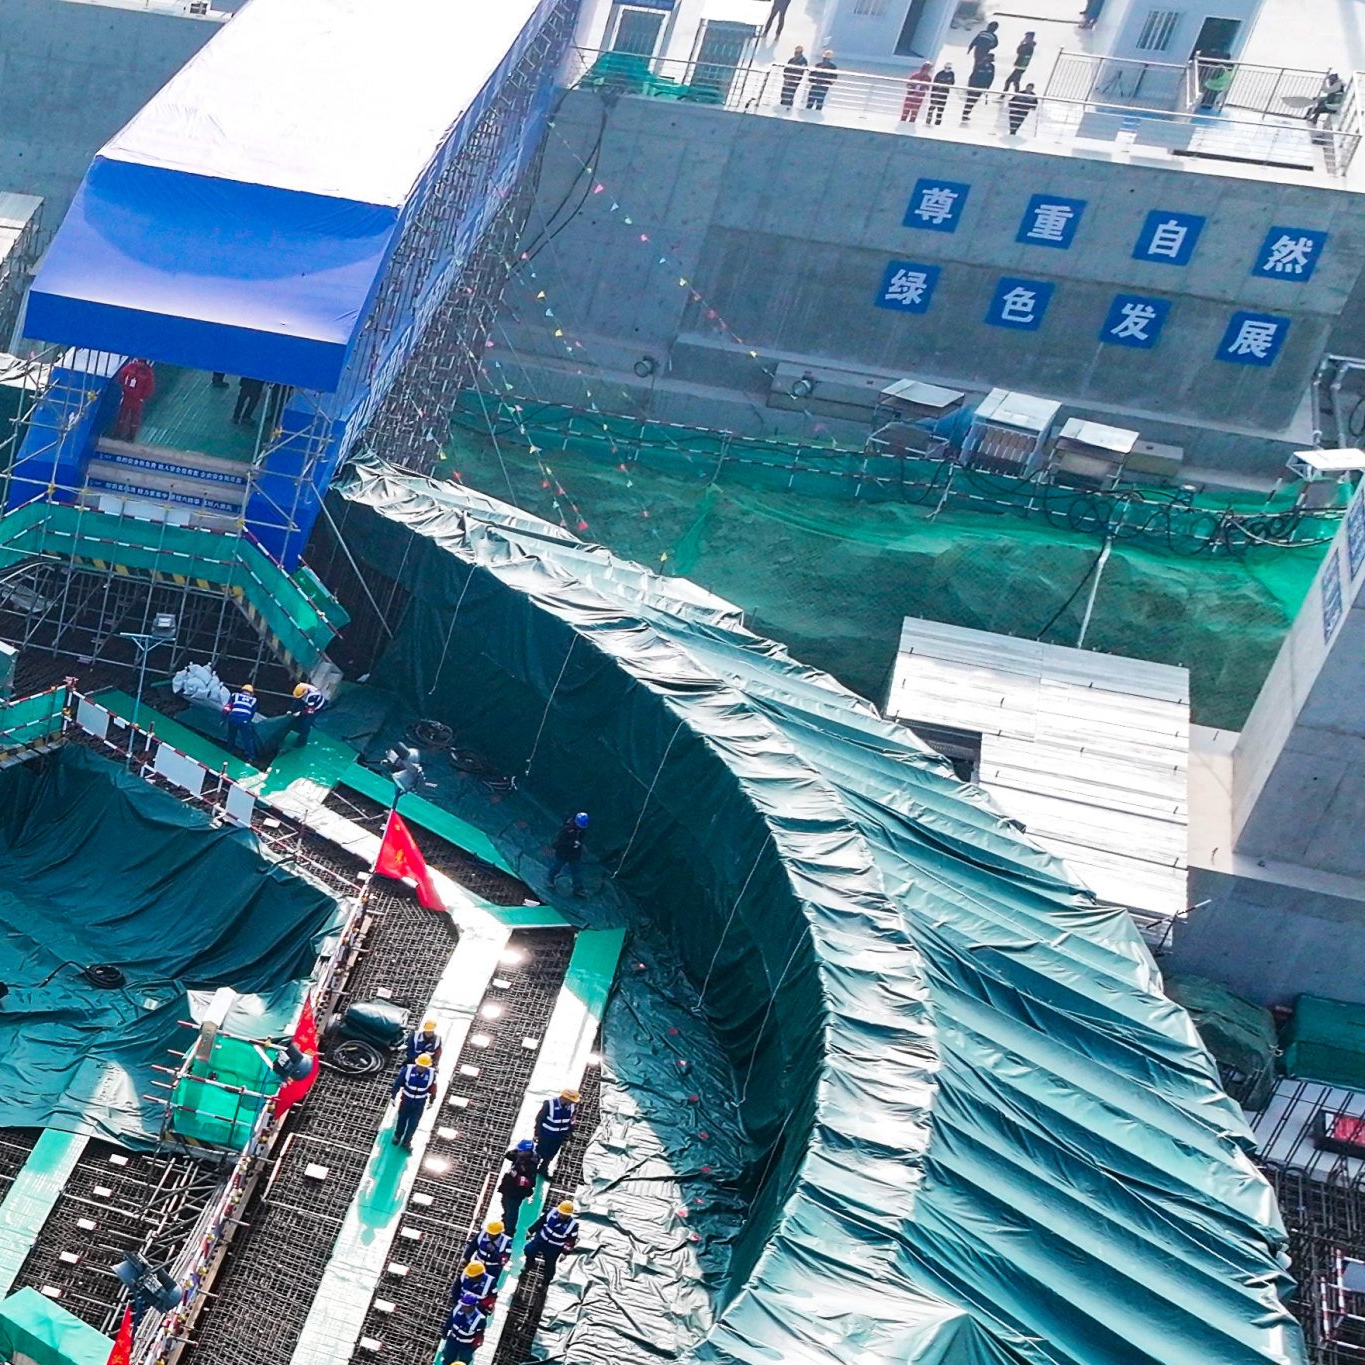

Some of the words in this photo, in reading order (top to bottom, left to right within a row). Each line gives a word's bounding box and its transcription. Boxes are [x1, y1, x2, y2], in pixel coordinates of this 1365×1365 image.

[914, 187, 1314, 275] 尊重自然
[884, 268, 1279, 359] 绿色发展
